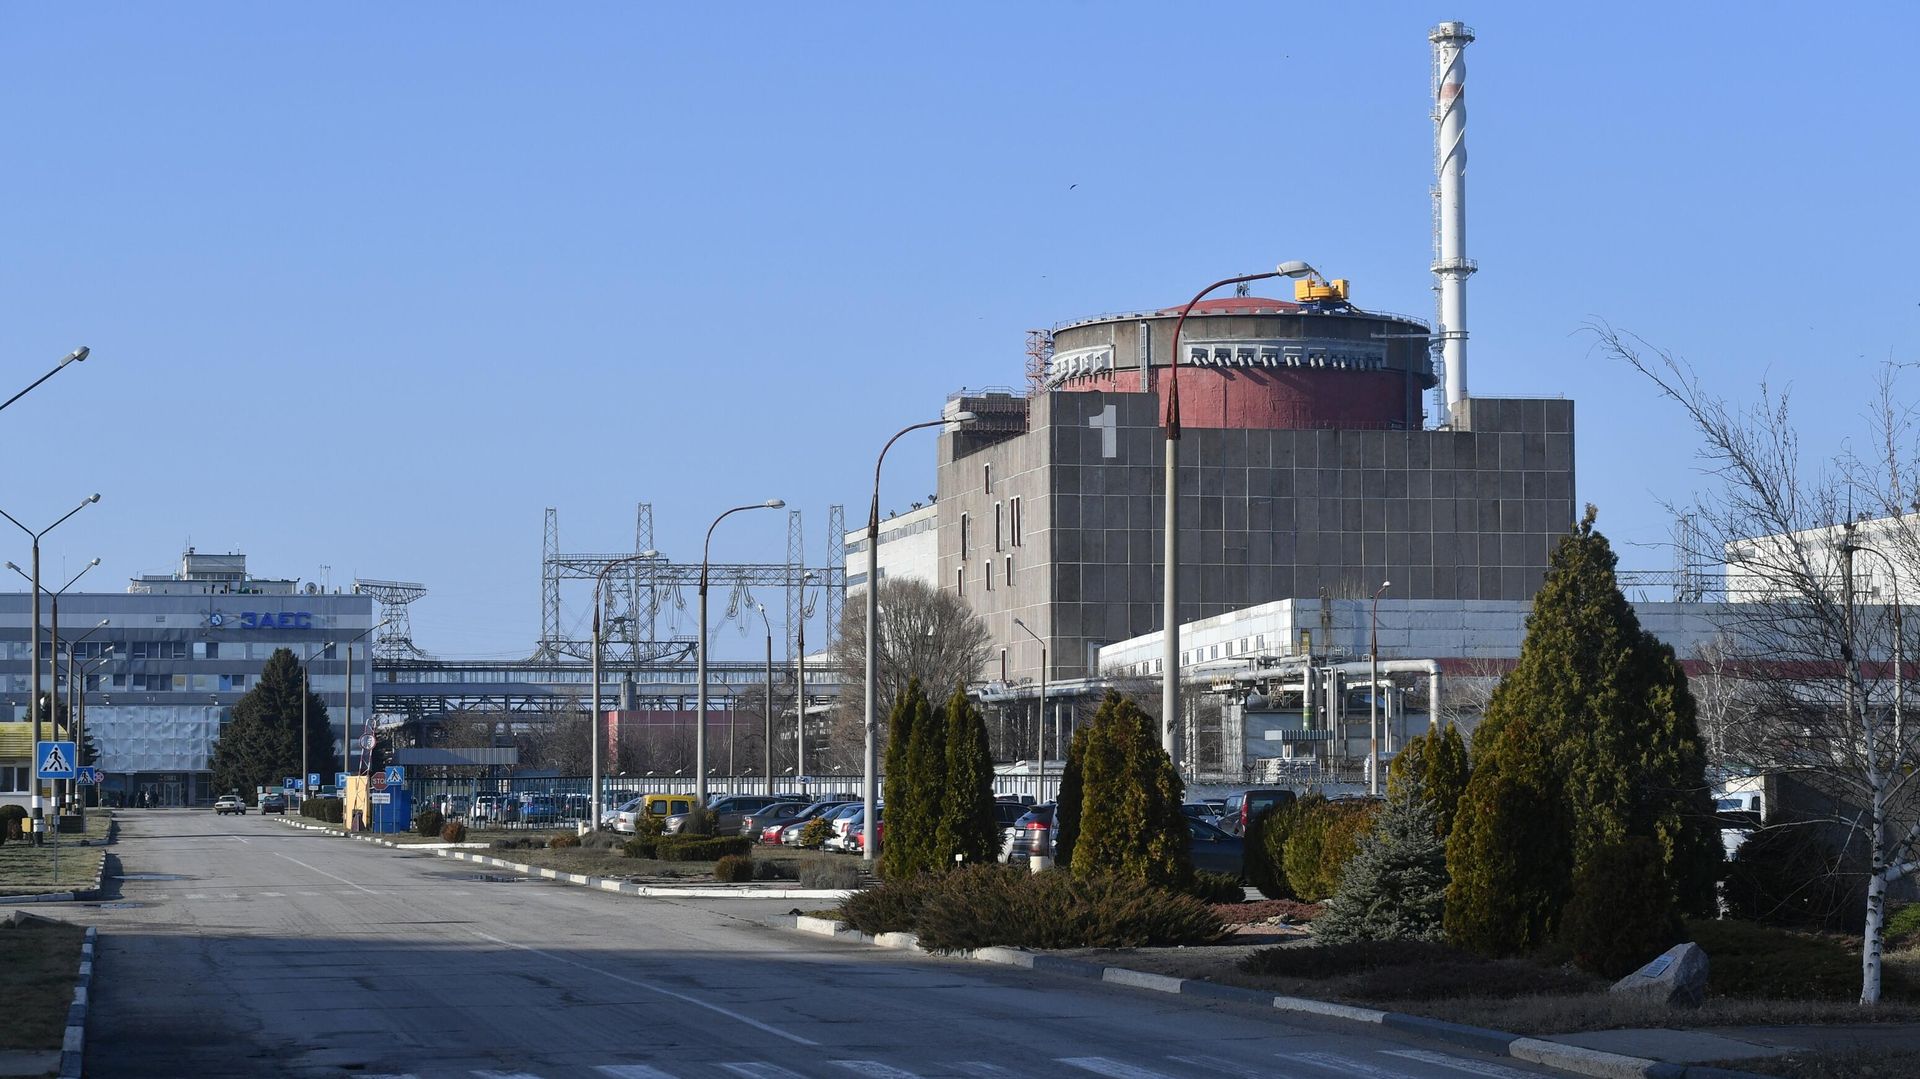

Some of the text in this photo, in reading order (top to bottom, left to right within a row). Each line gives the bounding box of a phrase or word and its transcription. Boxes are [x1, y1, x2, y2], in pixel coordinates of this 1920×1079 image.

[1089, 405, 1116, 457] 1
[241, 612, 312, 629] ЗАЕС
[286, 779, 293, 788] P
[311, 775, 317, 784] P
[338, 774, 346, 786] P
